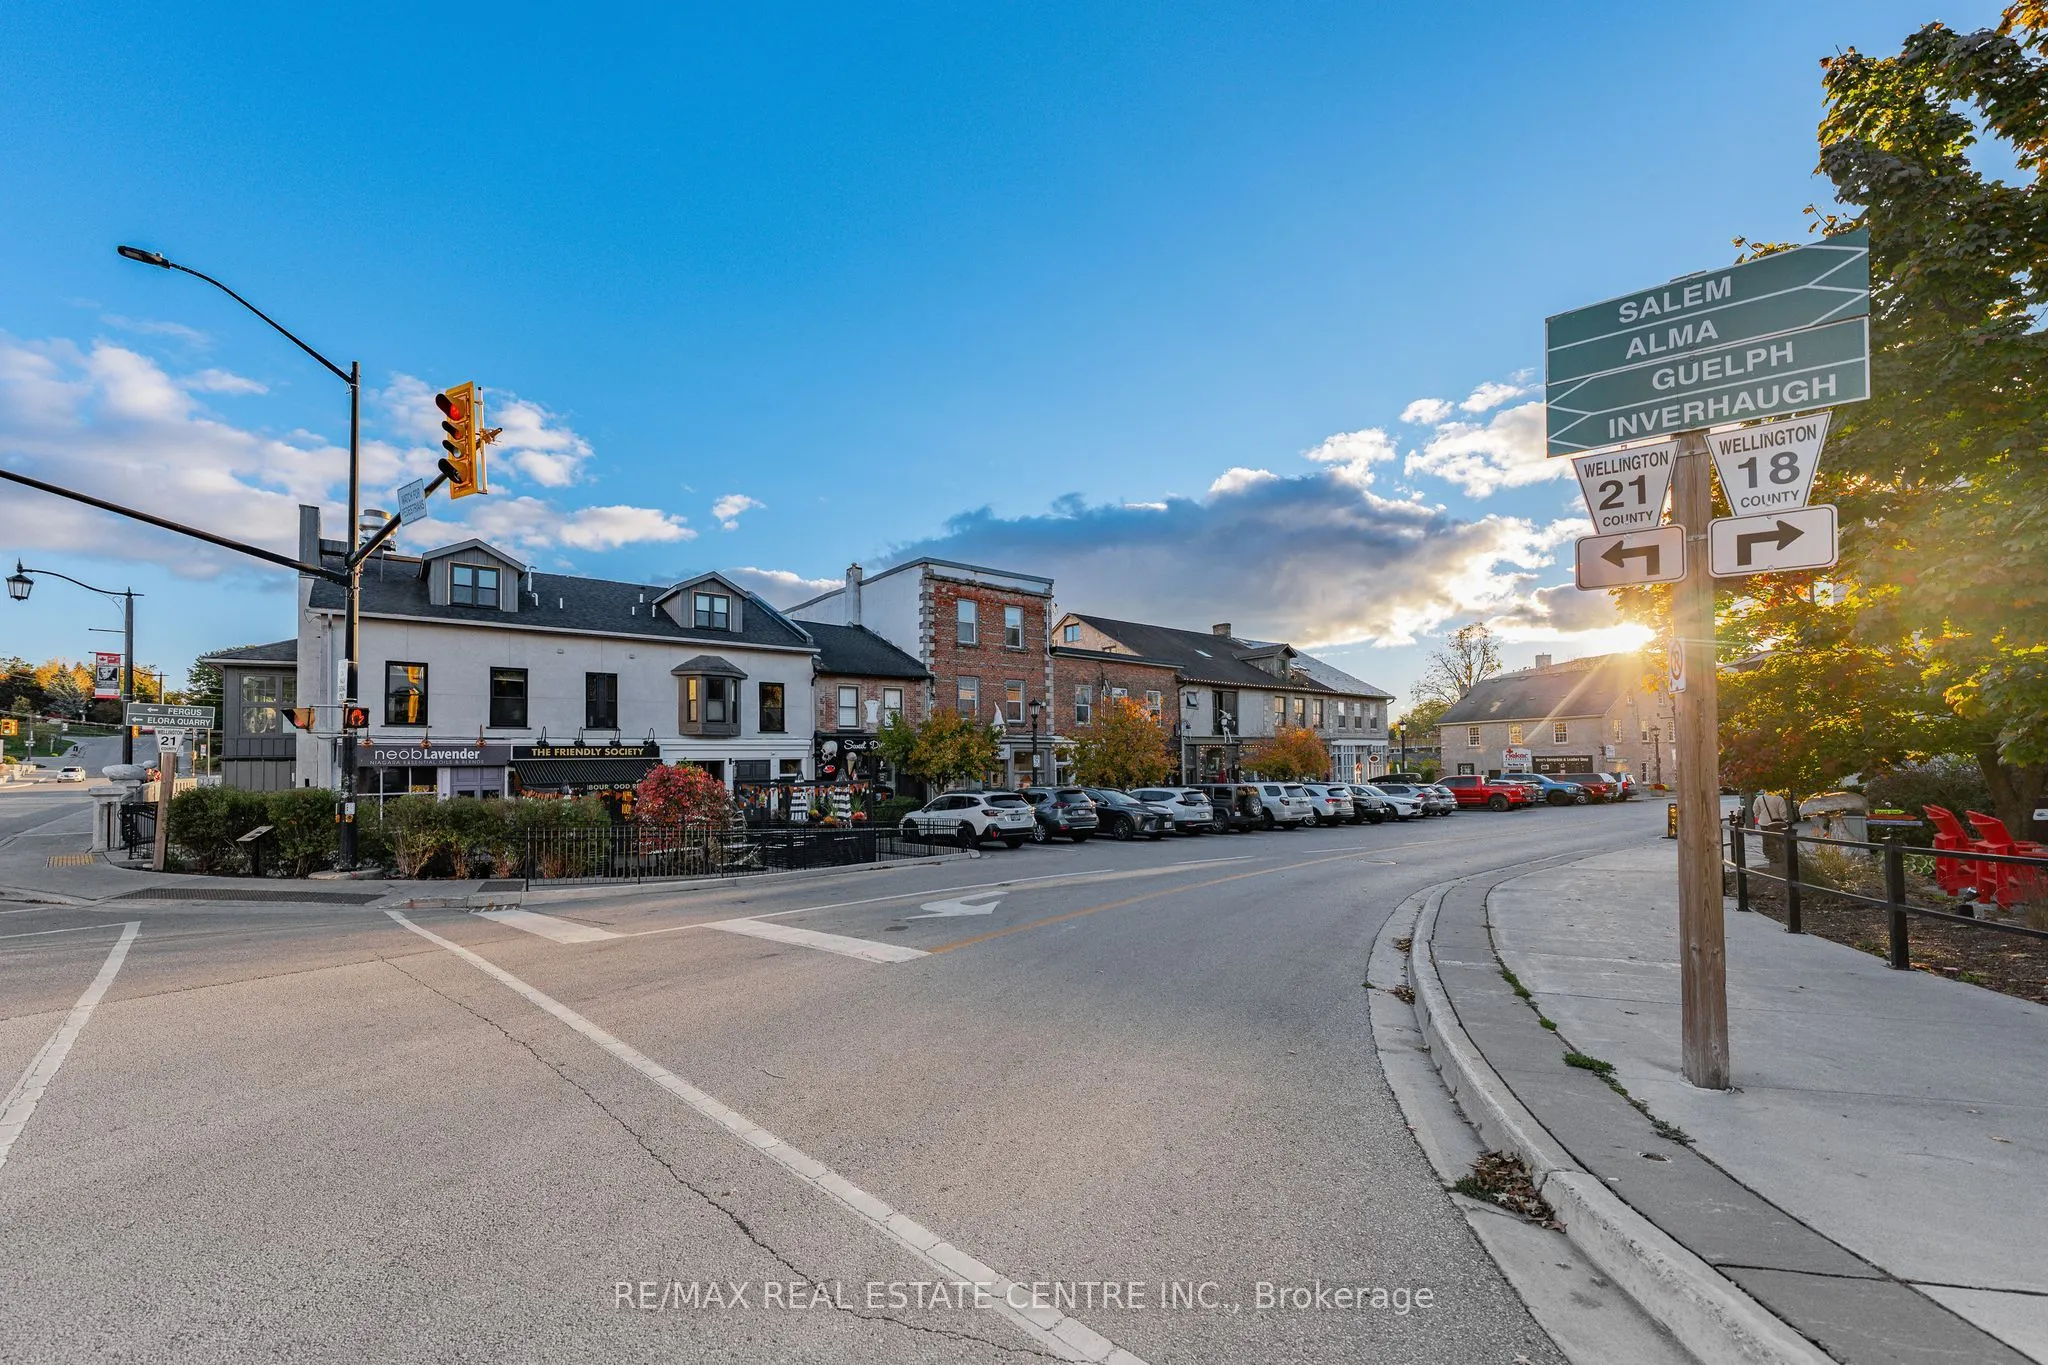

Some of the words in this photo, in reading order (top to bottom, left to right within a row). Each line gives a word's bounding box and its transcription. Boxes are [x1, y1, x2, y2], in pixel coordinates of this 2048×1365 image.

[1618, 275, 1732, 324] SALEM
[1625, 319, 1719, 360] ALMA
[1652, 340, 1793, 391] GUELPH
[1608, 373, 1837, 439] INVERHAUGH
[1718, 424, 1817, 456] WELLINGTON
[1584, 450, 1669, 478] WELLINGTON
[1737, 451, 1800, 489] 18
[1598, 475, 1648, 511] 21
[1740, 489, 1800, 509] COUNTY
[1602, 510, 1654, 528] COUNTY
[147, 716, 176, 724] ELORA
[177, 718, 211, 726] QUARRY
[167, 707, 202, 716] FERGUS
[160, 736, 176, 746] 21
[424, 748, 480, 760] Lavender
[531, 748, 551, 756] THE
[554, 747, 601, 756] FRIENDLY
[604, 747, 644, 756] SOCIETY
